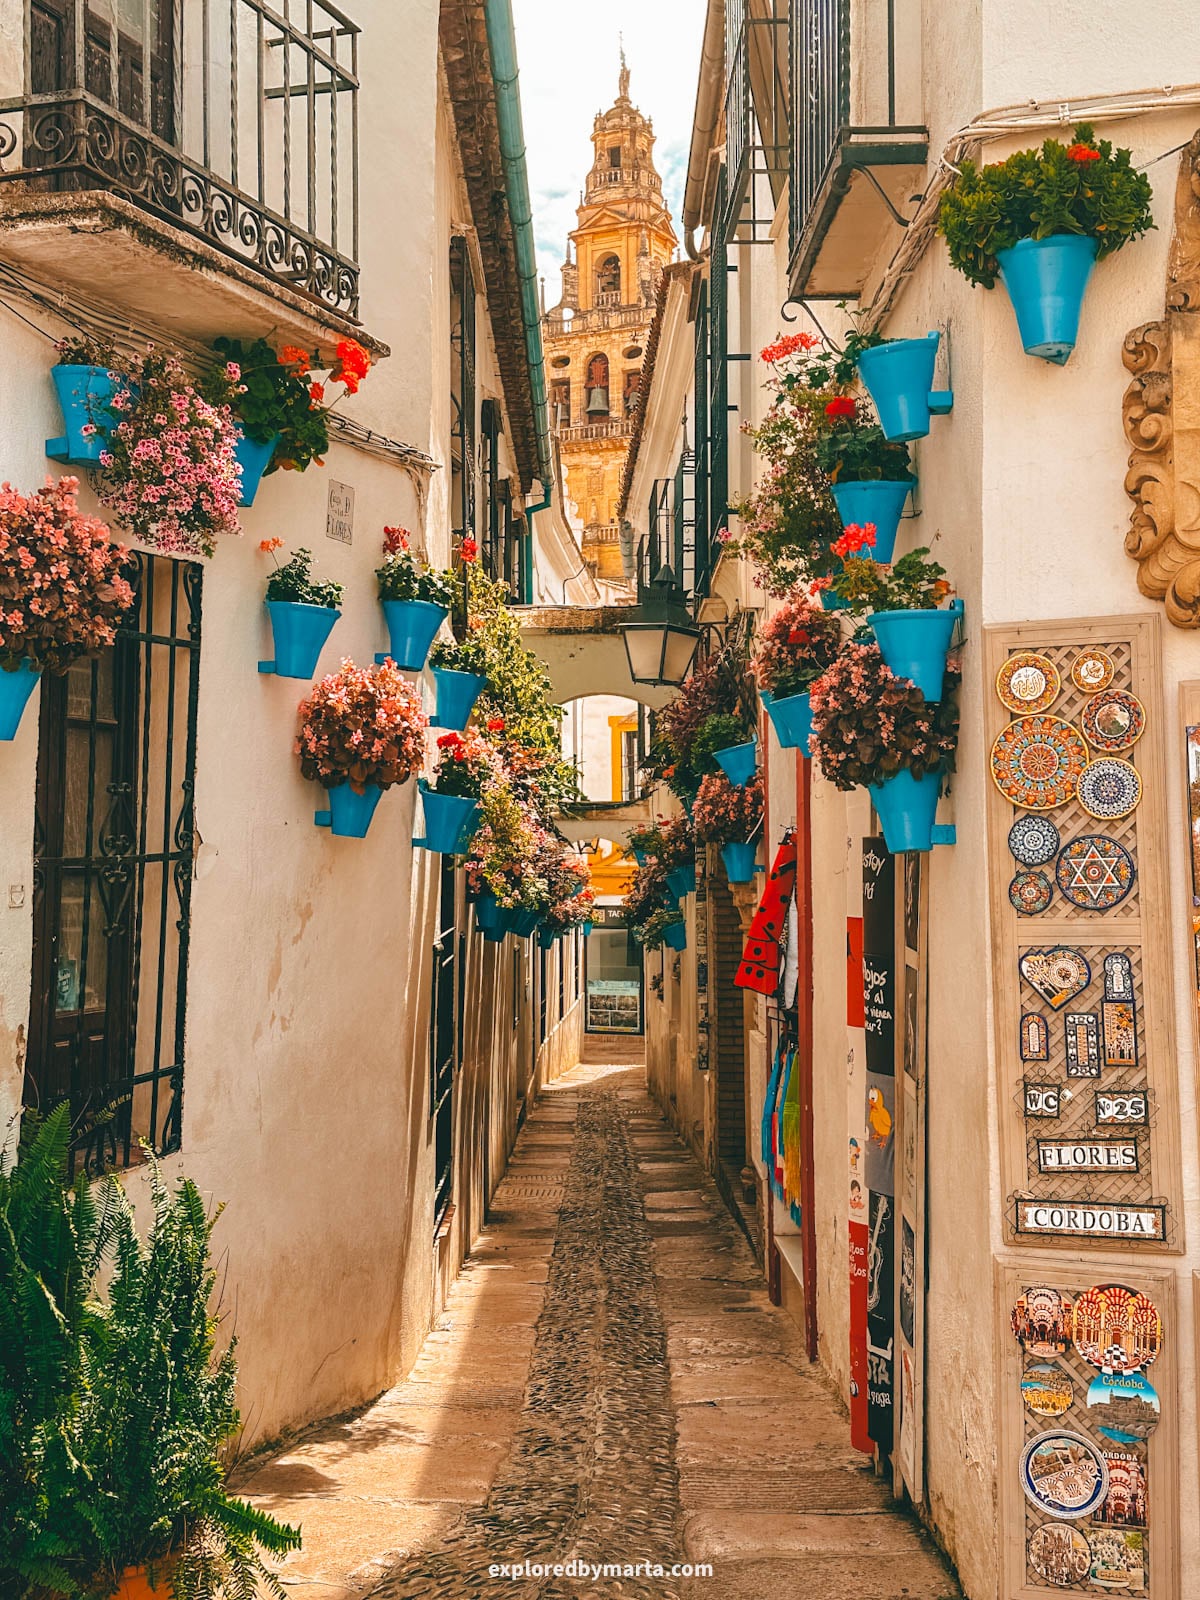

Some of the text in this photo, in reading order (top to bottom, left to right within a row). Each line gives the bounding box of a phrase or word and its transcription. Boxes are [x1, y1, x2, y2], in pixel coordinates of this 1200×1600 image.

[863, 849, 886, 876] stoy
[1027, 1093, 1057, 1110] WC
[1040, 1147, 1135, 1166] FLORES
[1034, 1209, 1145, 1232] CORDOBA
[1102, 1375, 1145, 1389] Córdoba
[871, 1391, 892, 1407] yoga
